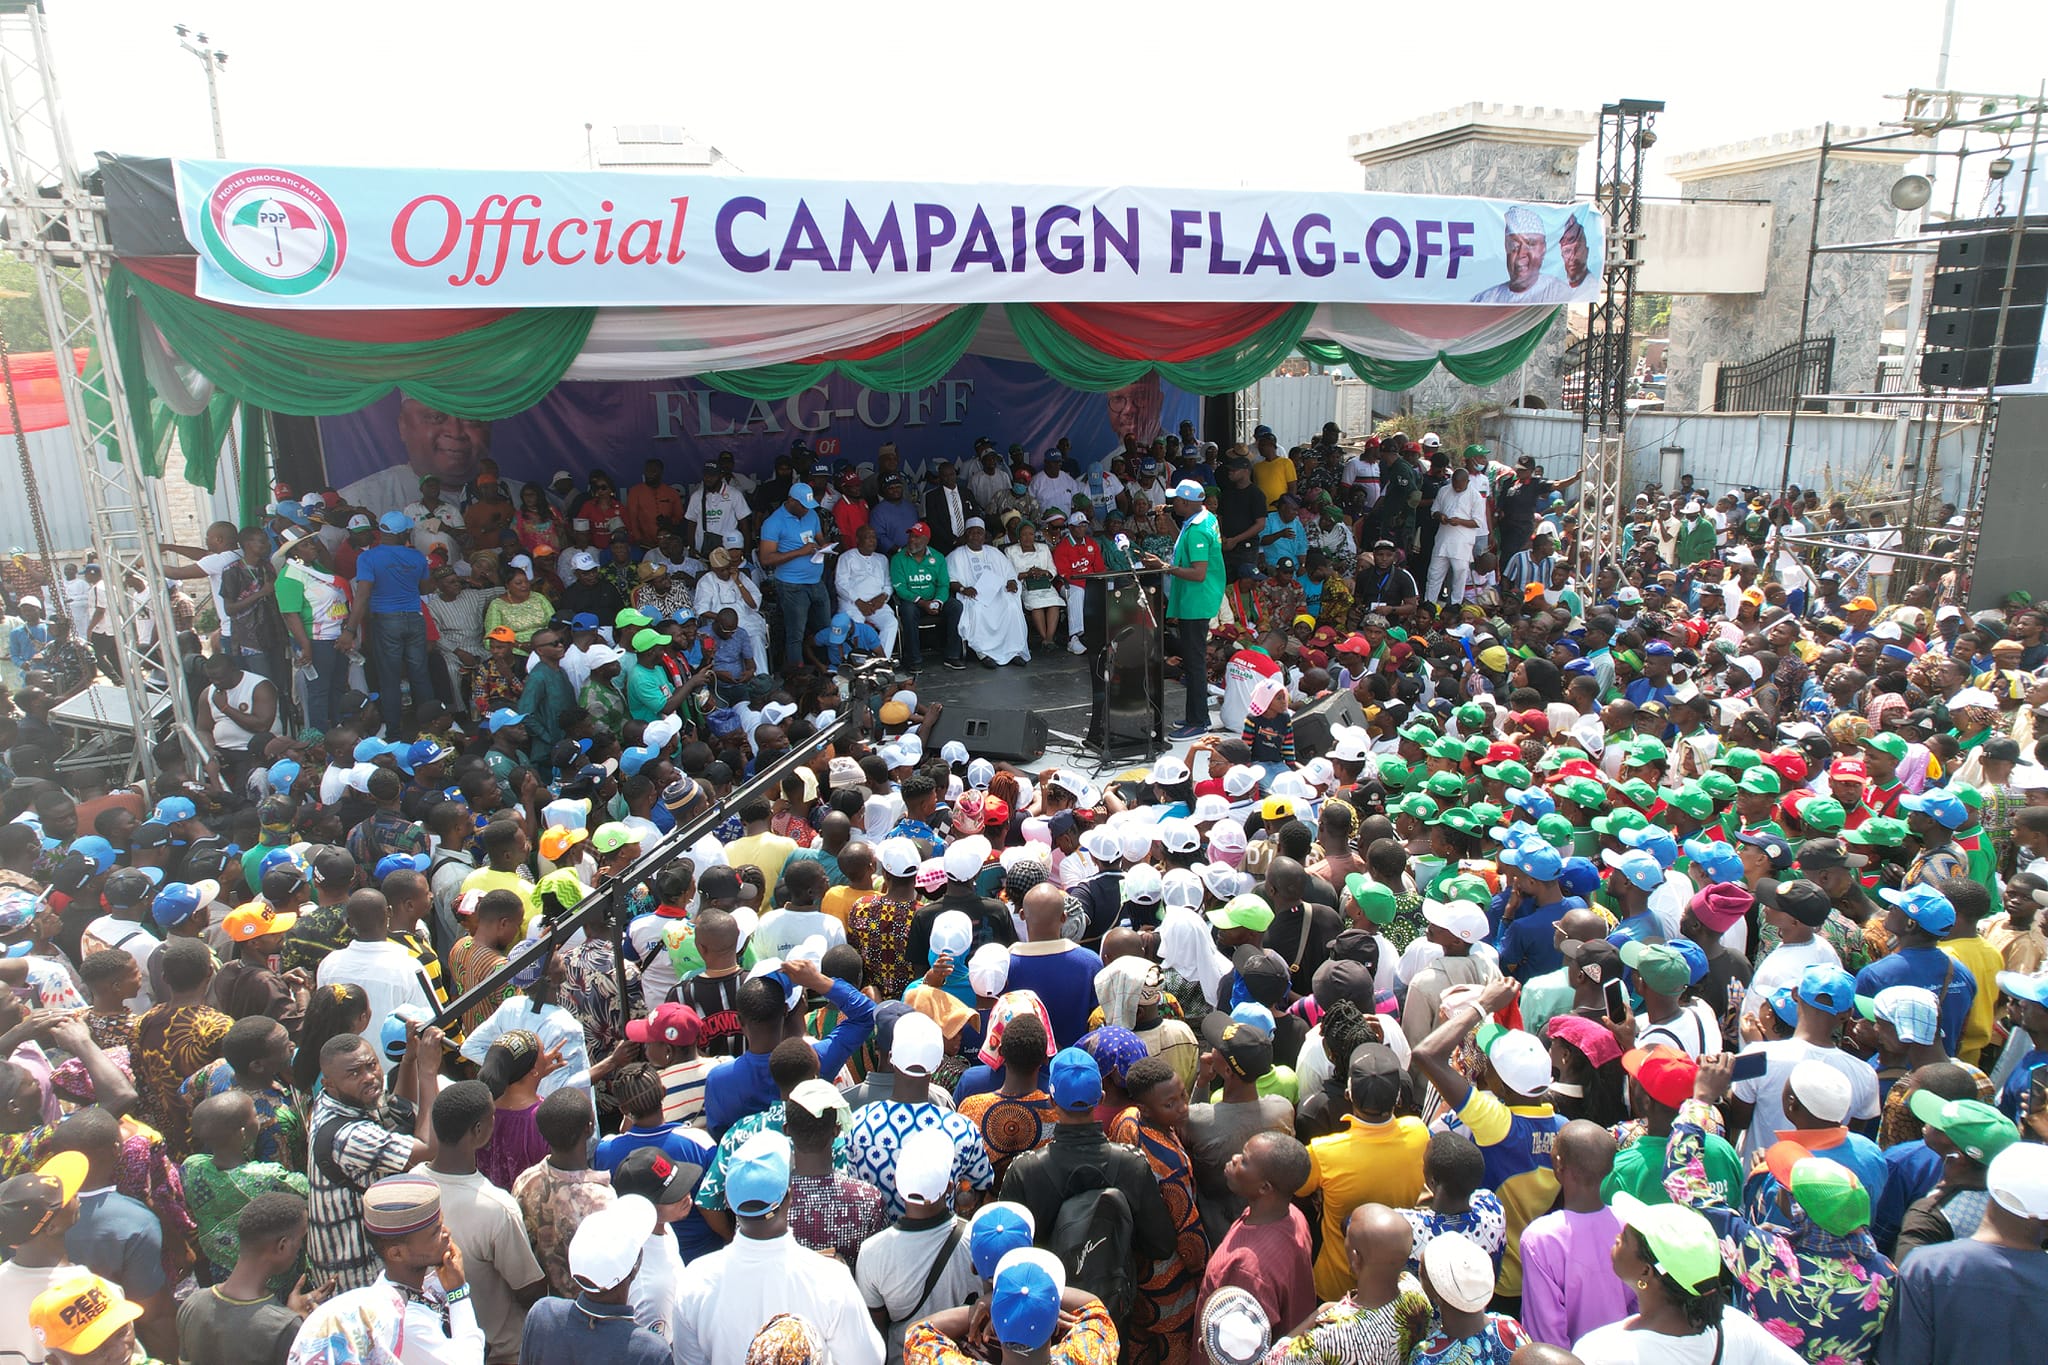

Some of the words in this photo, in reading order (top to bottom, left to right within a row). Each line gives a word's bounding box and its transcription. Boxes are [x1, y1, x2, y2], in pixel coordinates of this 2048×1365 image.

[218, 177, 246, 201] PEOPLES
[245, 174, 300, 188] DEMOCRATIC
[299, 183, 322, 202] PARTY
[260, 212, 287, 224] PDP
[391, 193, 690, 287] Official
[714, 195, 1140, 276] CAMPAIGN
[1169, 208, 1475, 280] FLAG-OFF
[649, 378, 975, 439] FLAG-OFF
[818, 439, 836, 455] Of
[909, 573, 932, 582] LADO
[487, 755, 502, 767] 17
